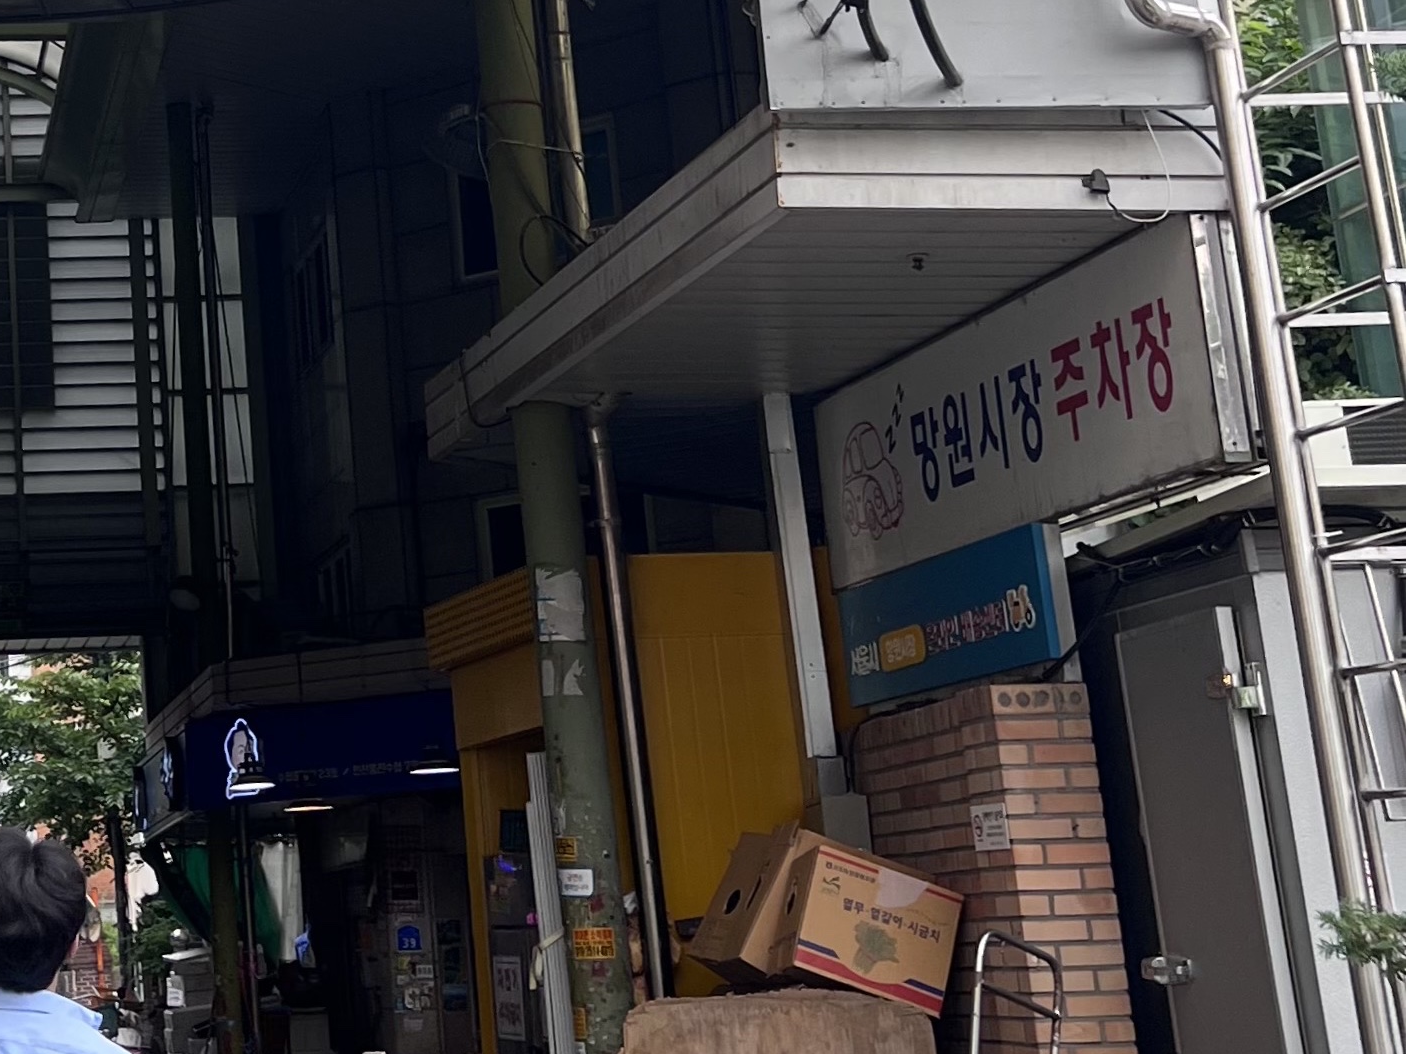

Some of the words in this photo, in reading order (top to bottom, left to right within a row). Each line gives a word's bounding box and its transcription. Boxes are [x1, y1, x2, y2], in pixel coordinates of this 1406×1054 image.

[910, 358, 1043, 502] 망원시장
[1049, 297, 1174, 441] 주차장
[402, 937, 418, 949] 39
[843, 897, 865, 914] 열무
[907, 920, 941, 943] 시금치
